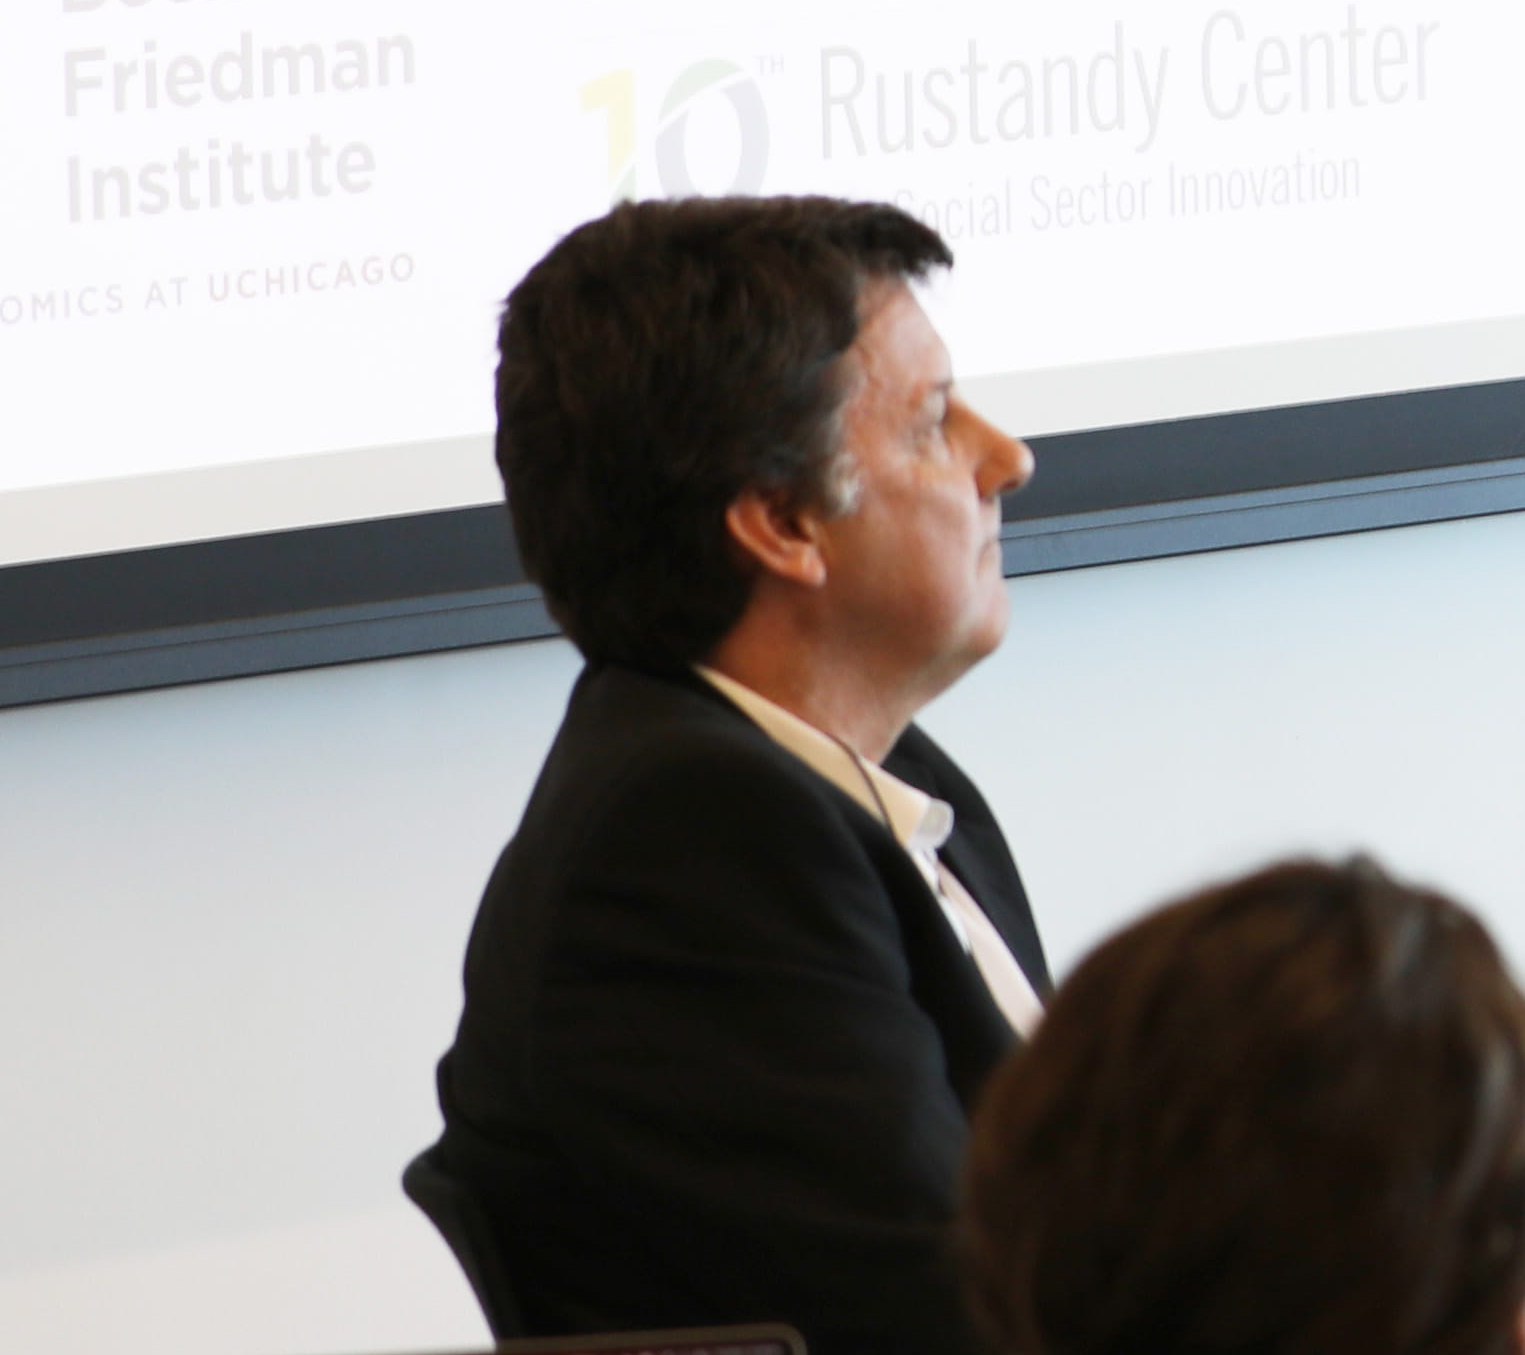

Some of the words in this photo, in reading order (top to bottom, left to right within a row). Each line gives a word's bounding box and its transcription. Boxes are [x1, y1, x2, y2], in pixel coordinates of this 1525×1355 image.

[63, 28, 417, 120] Friedman
[819, 19, 1171, 162] Rustandy
[1200, 3, 1441, 122] Center
[65, 131, 377, 224] Institute
[1029, 170, 1153, 233] Sector
[1167, 148, 1361, 218] Innovation
[143, 275, 189, 312] AT
[206, 251, 417, 304] UCHICAGO
